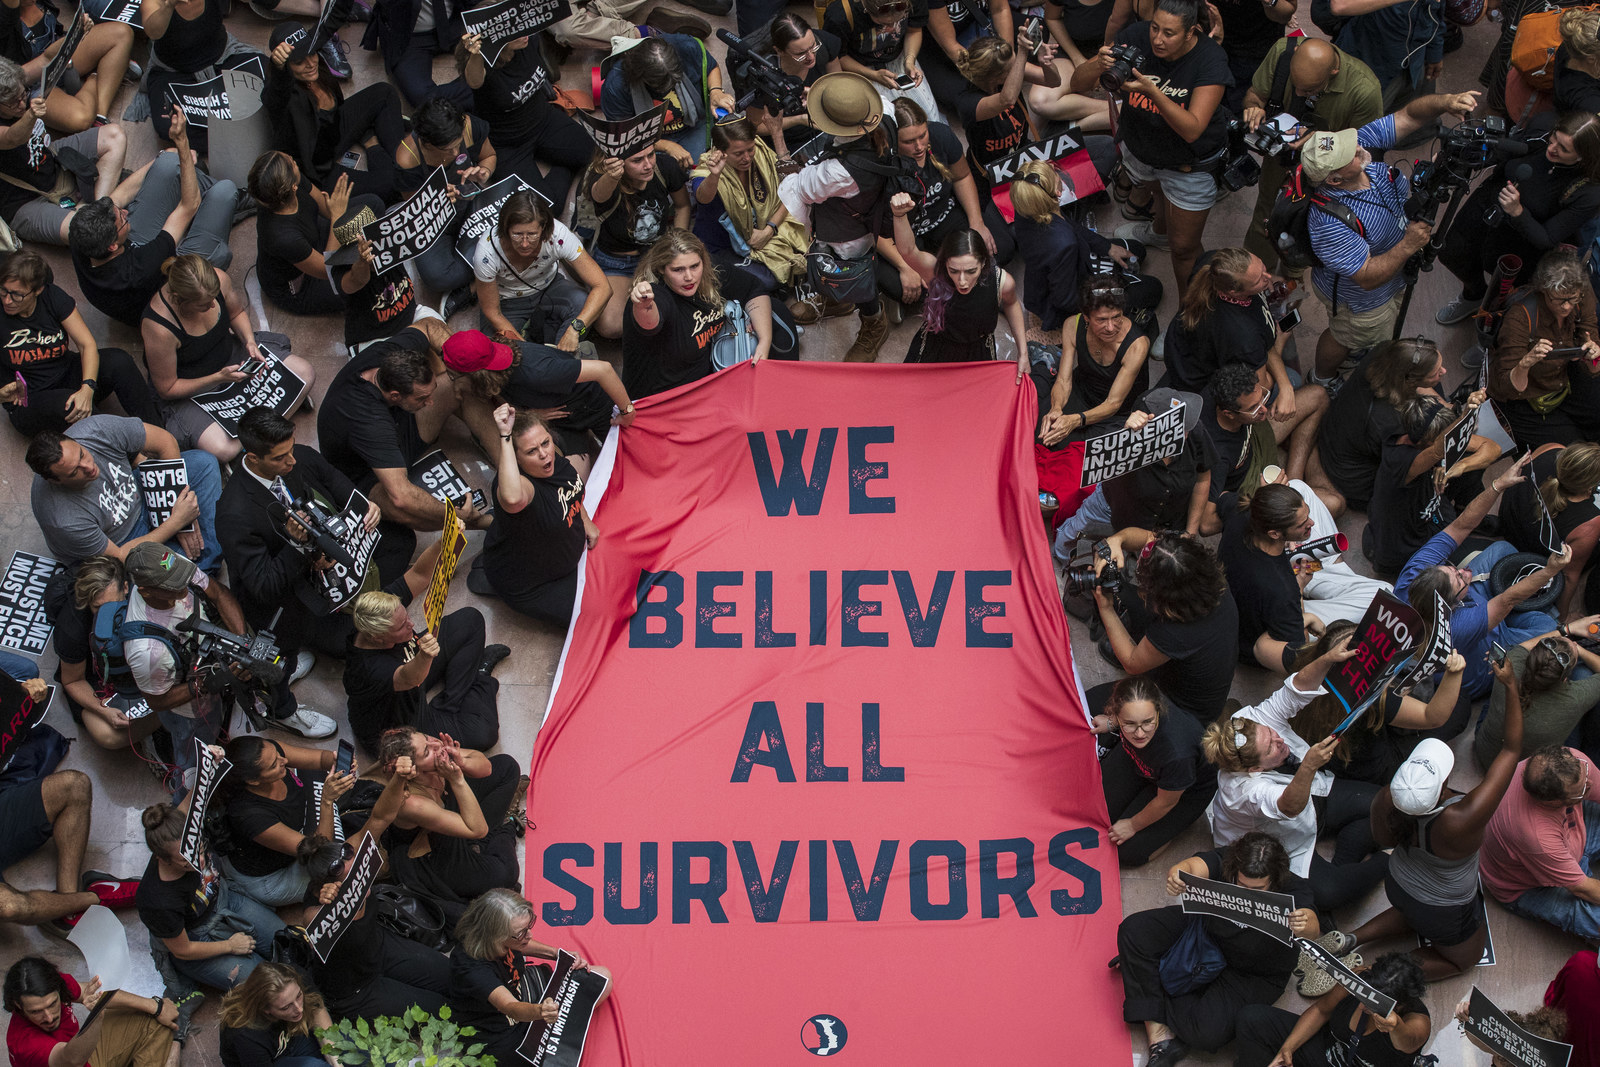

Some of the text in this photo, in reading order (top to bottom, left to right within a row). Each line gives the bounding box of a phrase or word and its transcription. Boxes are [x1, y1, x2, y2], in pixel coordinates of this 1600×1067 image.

[466, 8, 518, 36] CERTAIN
[490, 12, 553, 44] CHRISTINE
[515, 0, 559, 25] BLASEY
[372, 188, 446, 250] VIOLENCE
[379, 184, 438, 236] SEXUAL
[374, 202, 453, 270] IS A CRIME
[200, 394, 246, 412] CERTAIN
[246, 370, 282, 410] BLASEY
[1083, 422, 1184, 471] INJUSTICE
[1090, 409, 1180, 454] SUPREME
[746, 426, 896, 516] WE
[1088, 442, 1177, 484] MUST END
[0, 557, 34, 603] MUST
[2, 556, 57, 649] INJUSTICE
[346, 576, 358, 594] A
[628, 568, 1014, 648] BELIEVE
[1412, 598, 1445, 682] PATTERN
[730, 701, 905, 783] ALL
[182, 742, 214, 860] KAVANAUGH
[310, 840, 376, 944] KAVANAUGH
[542, 826, 1103, 926] SURVIVORS
[327, 864, 371, 939] IS UNFIT
[1182, 892, 1252, 915] DANGEROUS
[1254, 901, 1280, 914] WAS
[1333, 970, 1380, 1005] WILL
[546, 979, 580, 1056] IS A WHITEWASH
[1477, 1022, 1502, 1045] 100%
[1489, 1016, 1540, 1057] CHRISTINE
[533, 1045, 545, 1067] THE
[540, 1028, 550, 1046] FBI
[1482, 1018, 1546, 1067] BLASEY FORD
